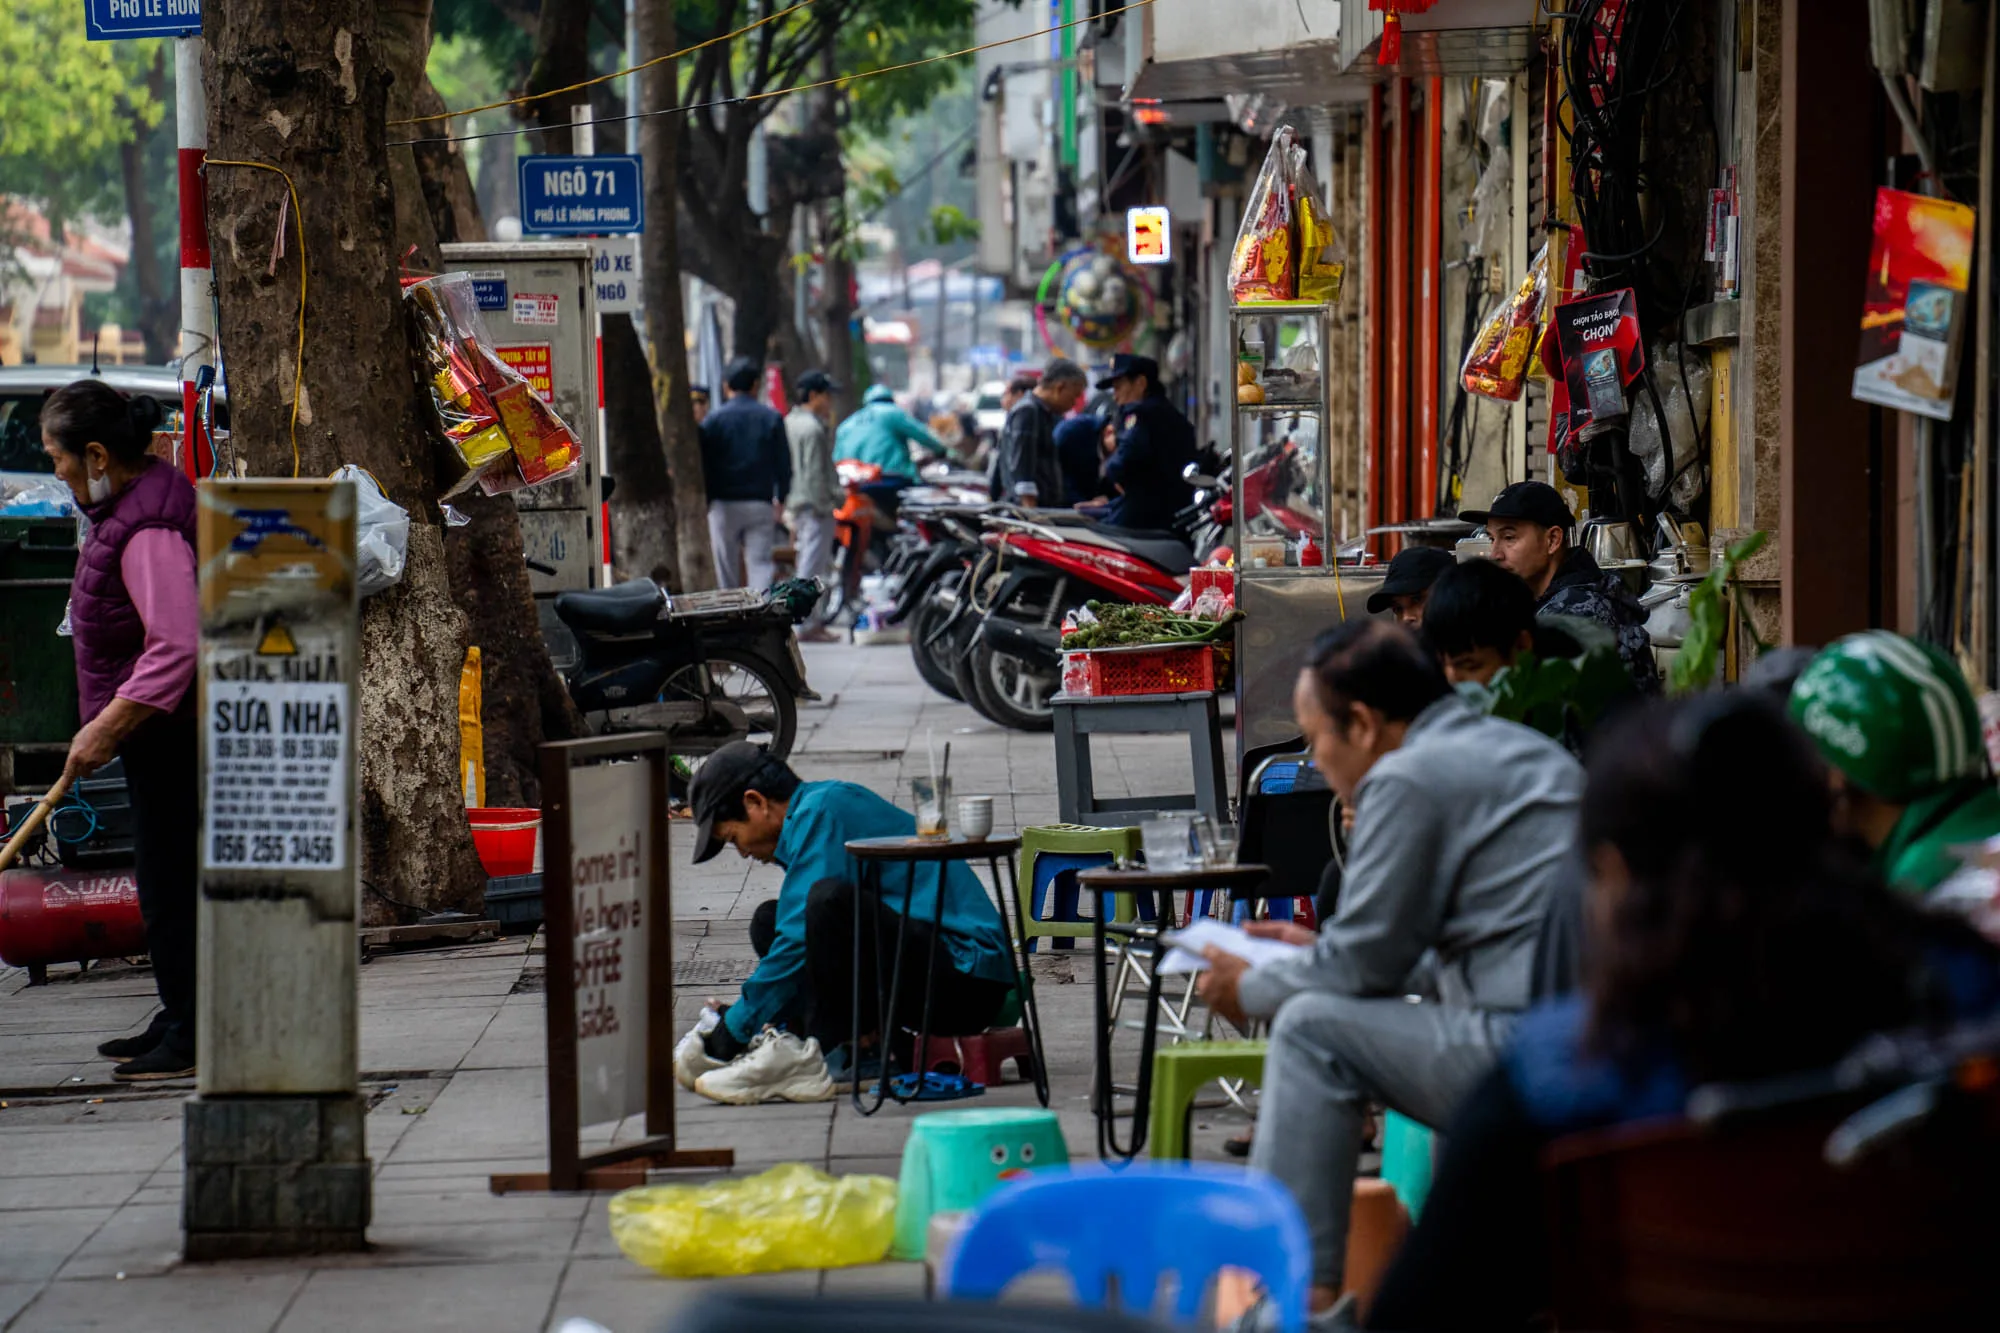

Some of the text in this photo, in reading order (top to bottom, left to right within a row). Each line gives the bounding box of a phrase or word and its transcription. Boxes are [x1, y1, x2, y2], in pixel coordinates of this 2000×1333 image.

[543, 165, 616, 197] NGÕ 71
[534, 204, 631, 223] PHỐ LÊ HỒNG PHONG
[614, 255, 632, 272] XE
[1573, 316, 1591, 327] CHỌN
[1583, 323, 1614, 343] CHỌN
[214, 684, 340, 734] SỬA NHÀ
[213, 834, 334, 864] 056 255 3456
[574, 853, 616, 886] ome
